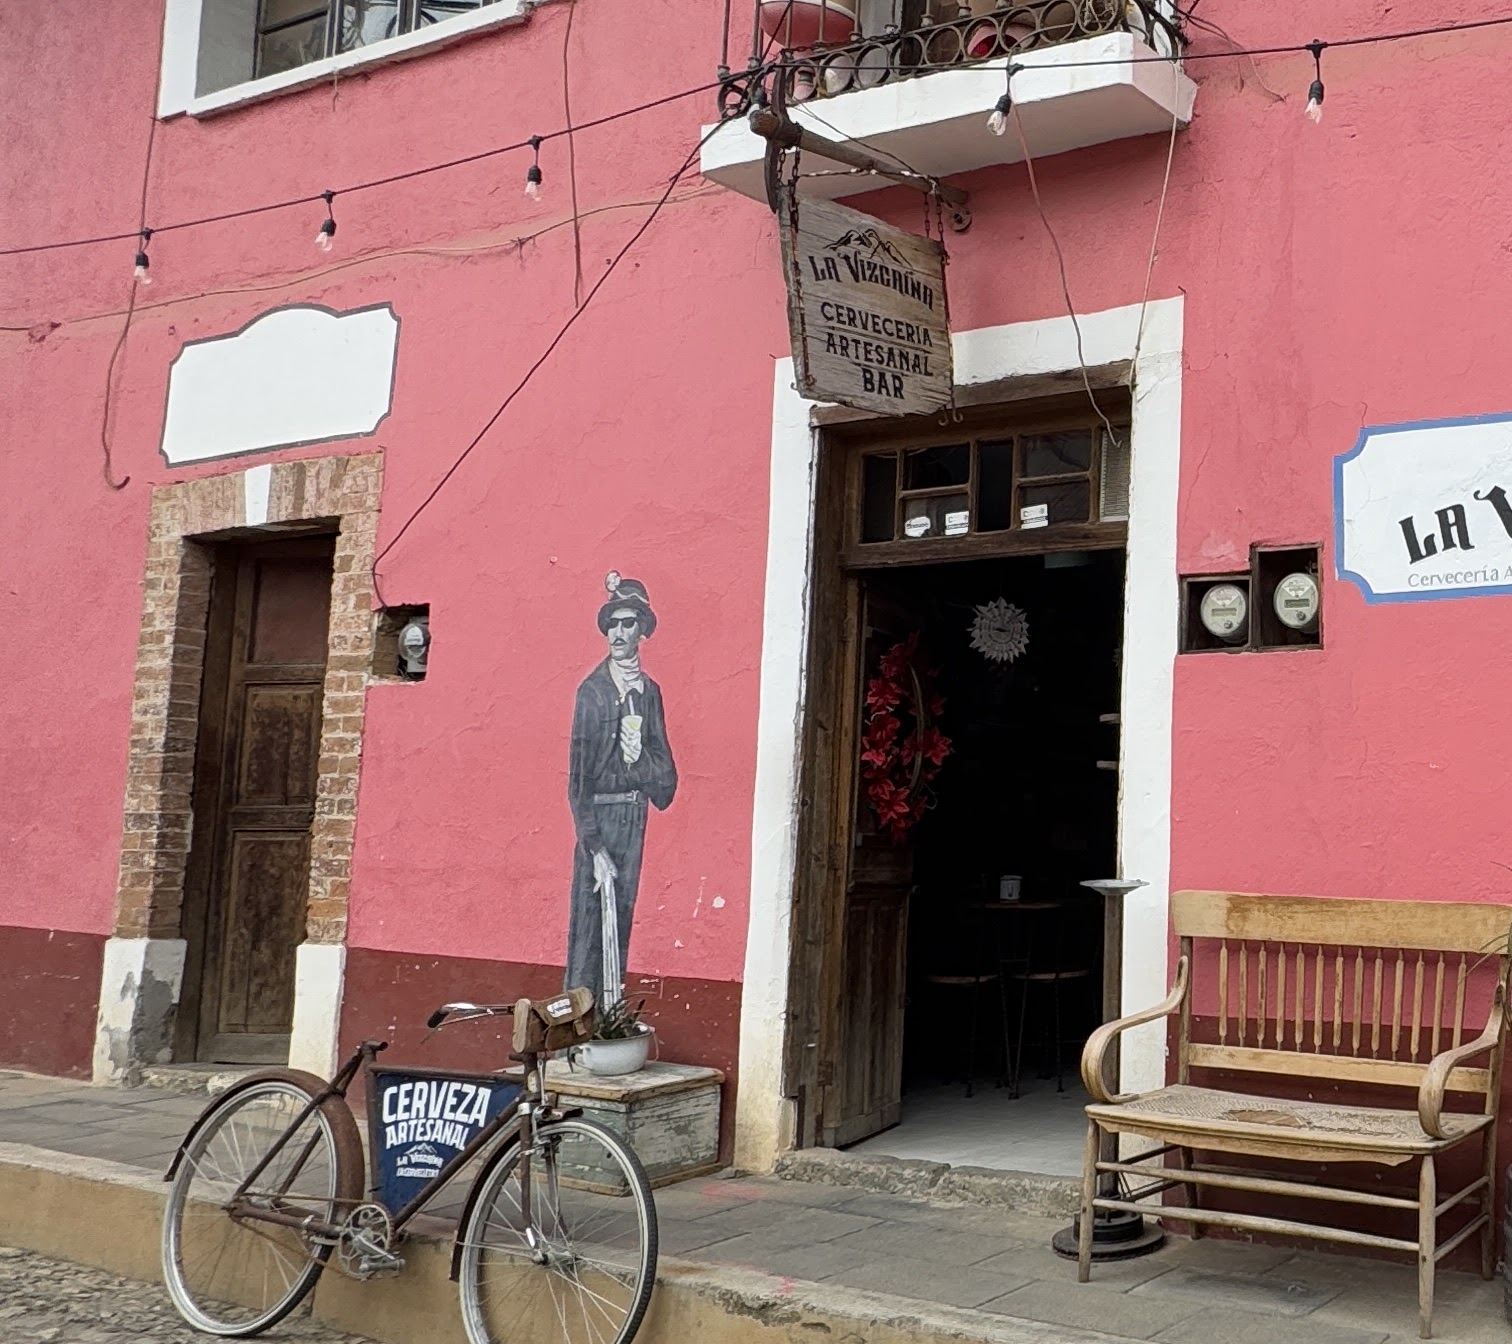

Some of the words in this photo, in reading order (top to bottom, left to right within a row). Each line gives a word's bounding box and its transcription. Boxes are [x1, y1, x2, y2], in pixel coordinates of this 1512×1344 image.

[807, 254, 843, 284] LA
[820, 301, 934, 348] CERVECERIA
[825, 331, 935, 377] ARTESANAL
[861, 368, 905, 399] BAR
[1398, 503, 1475, 566] LA
[1407, 564, 1499, 588] Cervecería
[381, 1081, 492, 1128] CERVEZA
[385, 1119, 469, 1150] ARTESANAL
